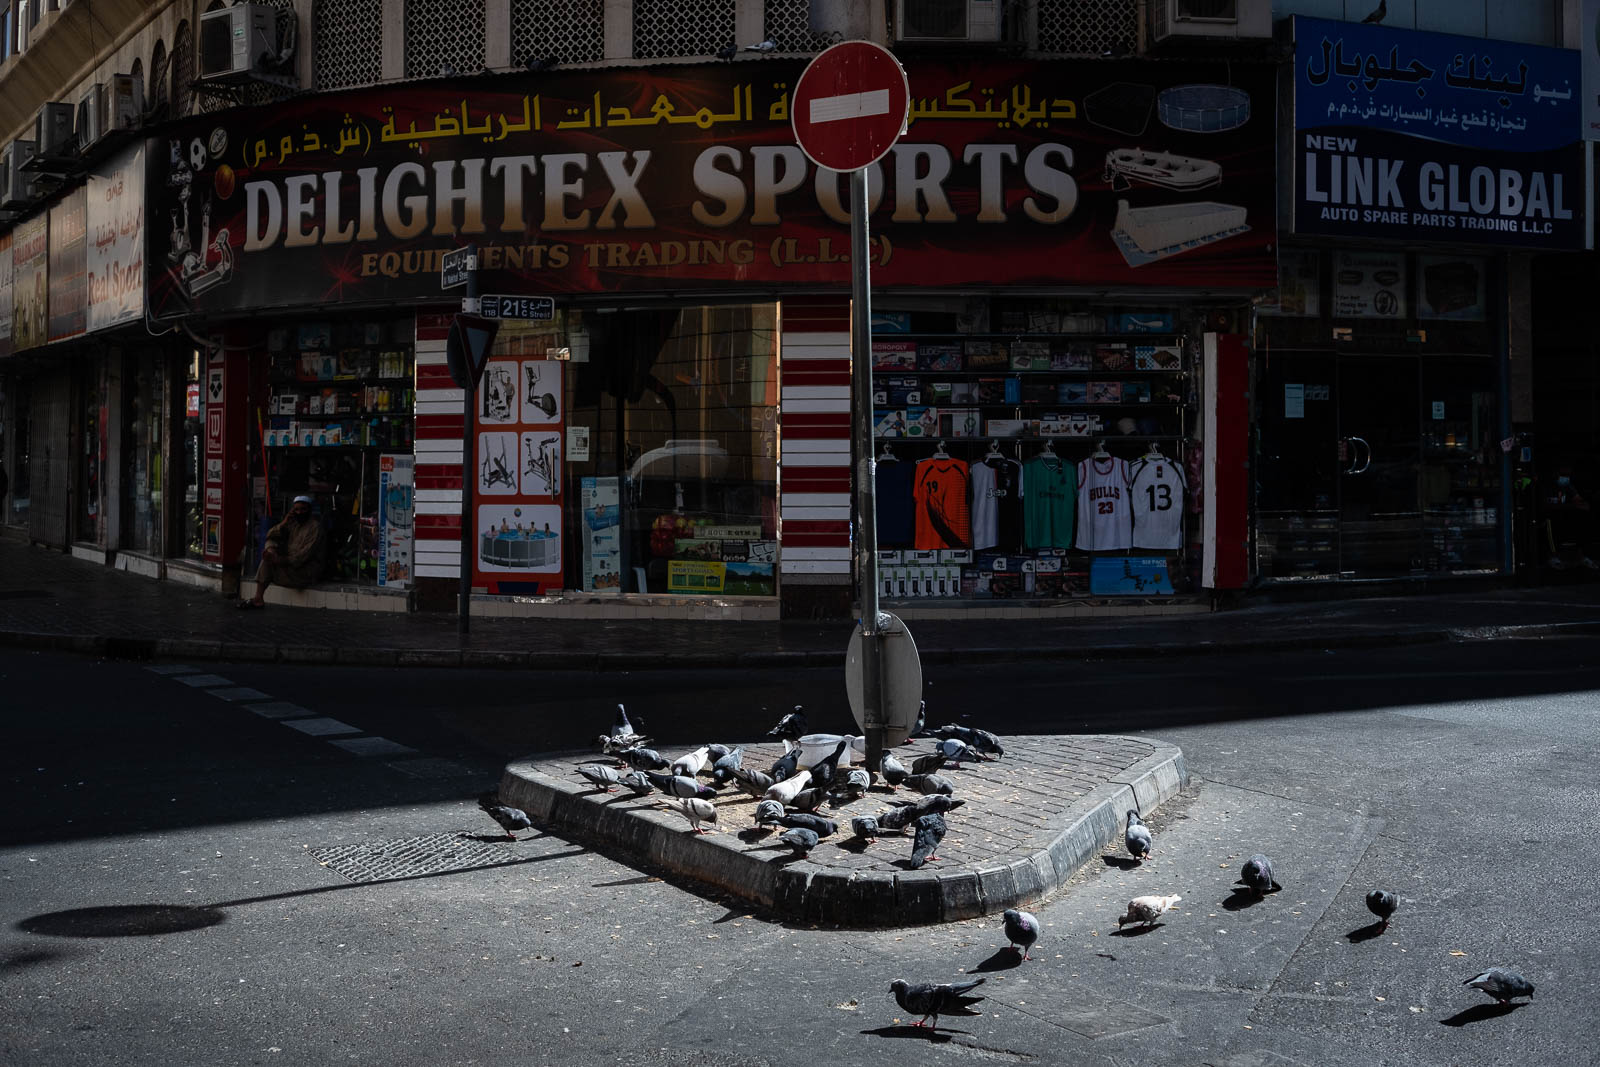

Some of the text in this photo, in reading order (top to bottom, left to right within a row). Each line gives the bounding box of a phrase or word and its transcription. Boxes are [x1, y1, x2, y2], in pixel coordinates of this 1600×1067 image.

[1305, 36, 1572, 108] نيو لينك جلوبال
[556, 83, 753, 130] المعدات
[381, 93, 541, 150] الرياضية
[1305, 134, 1358, 153] NEW
[243, 142, 1080, 252] DELIGHTEX SPORTS
[1305, 151, 1573, 221] LINK GLOBAL
[1321, 207, 1359, 222] AUTO
[1363, 209, 1409, 226] SPARE
[1413, 213, 1457, 229] PARTS
[1459, 216, 1518, 233] TRADING
[584, 239, 755, 269] TRADING
[88, 262, 109, 306] Real
[113, 254, 142, 305] Sport
[484, 309, 496, 317] 118
[503, 299, 519, 316] 21
[530, 310, 551, 319] Street
[926, 480, 938, 494] 19
[1089, 486, 1120, 501] BULLS
[1145, 484, 1173, 512] 13
[1097, 501, 1114, 515] 23
